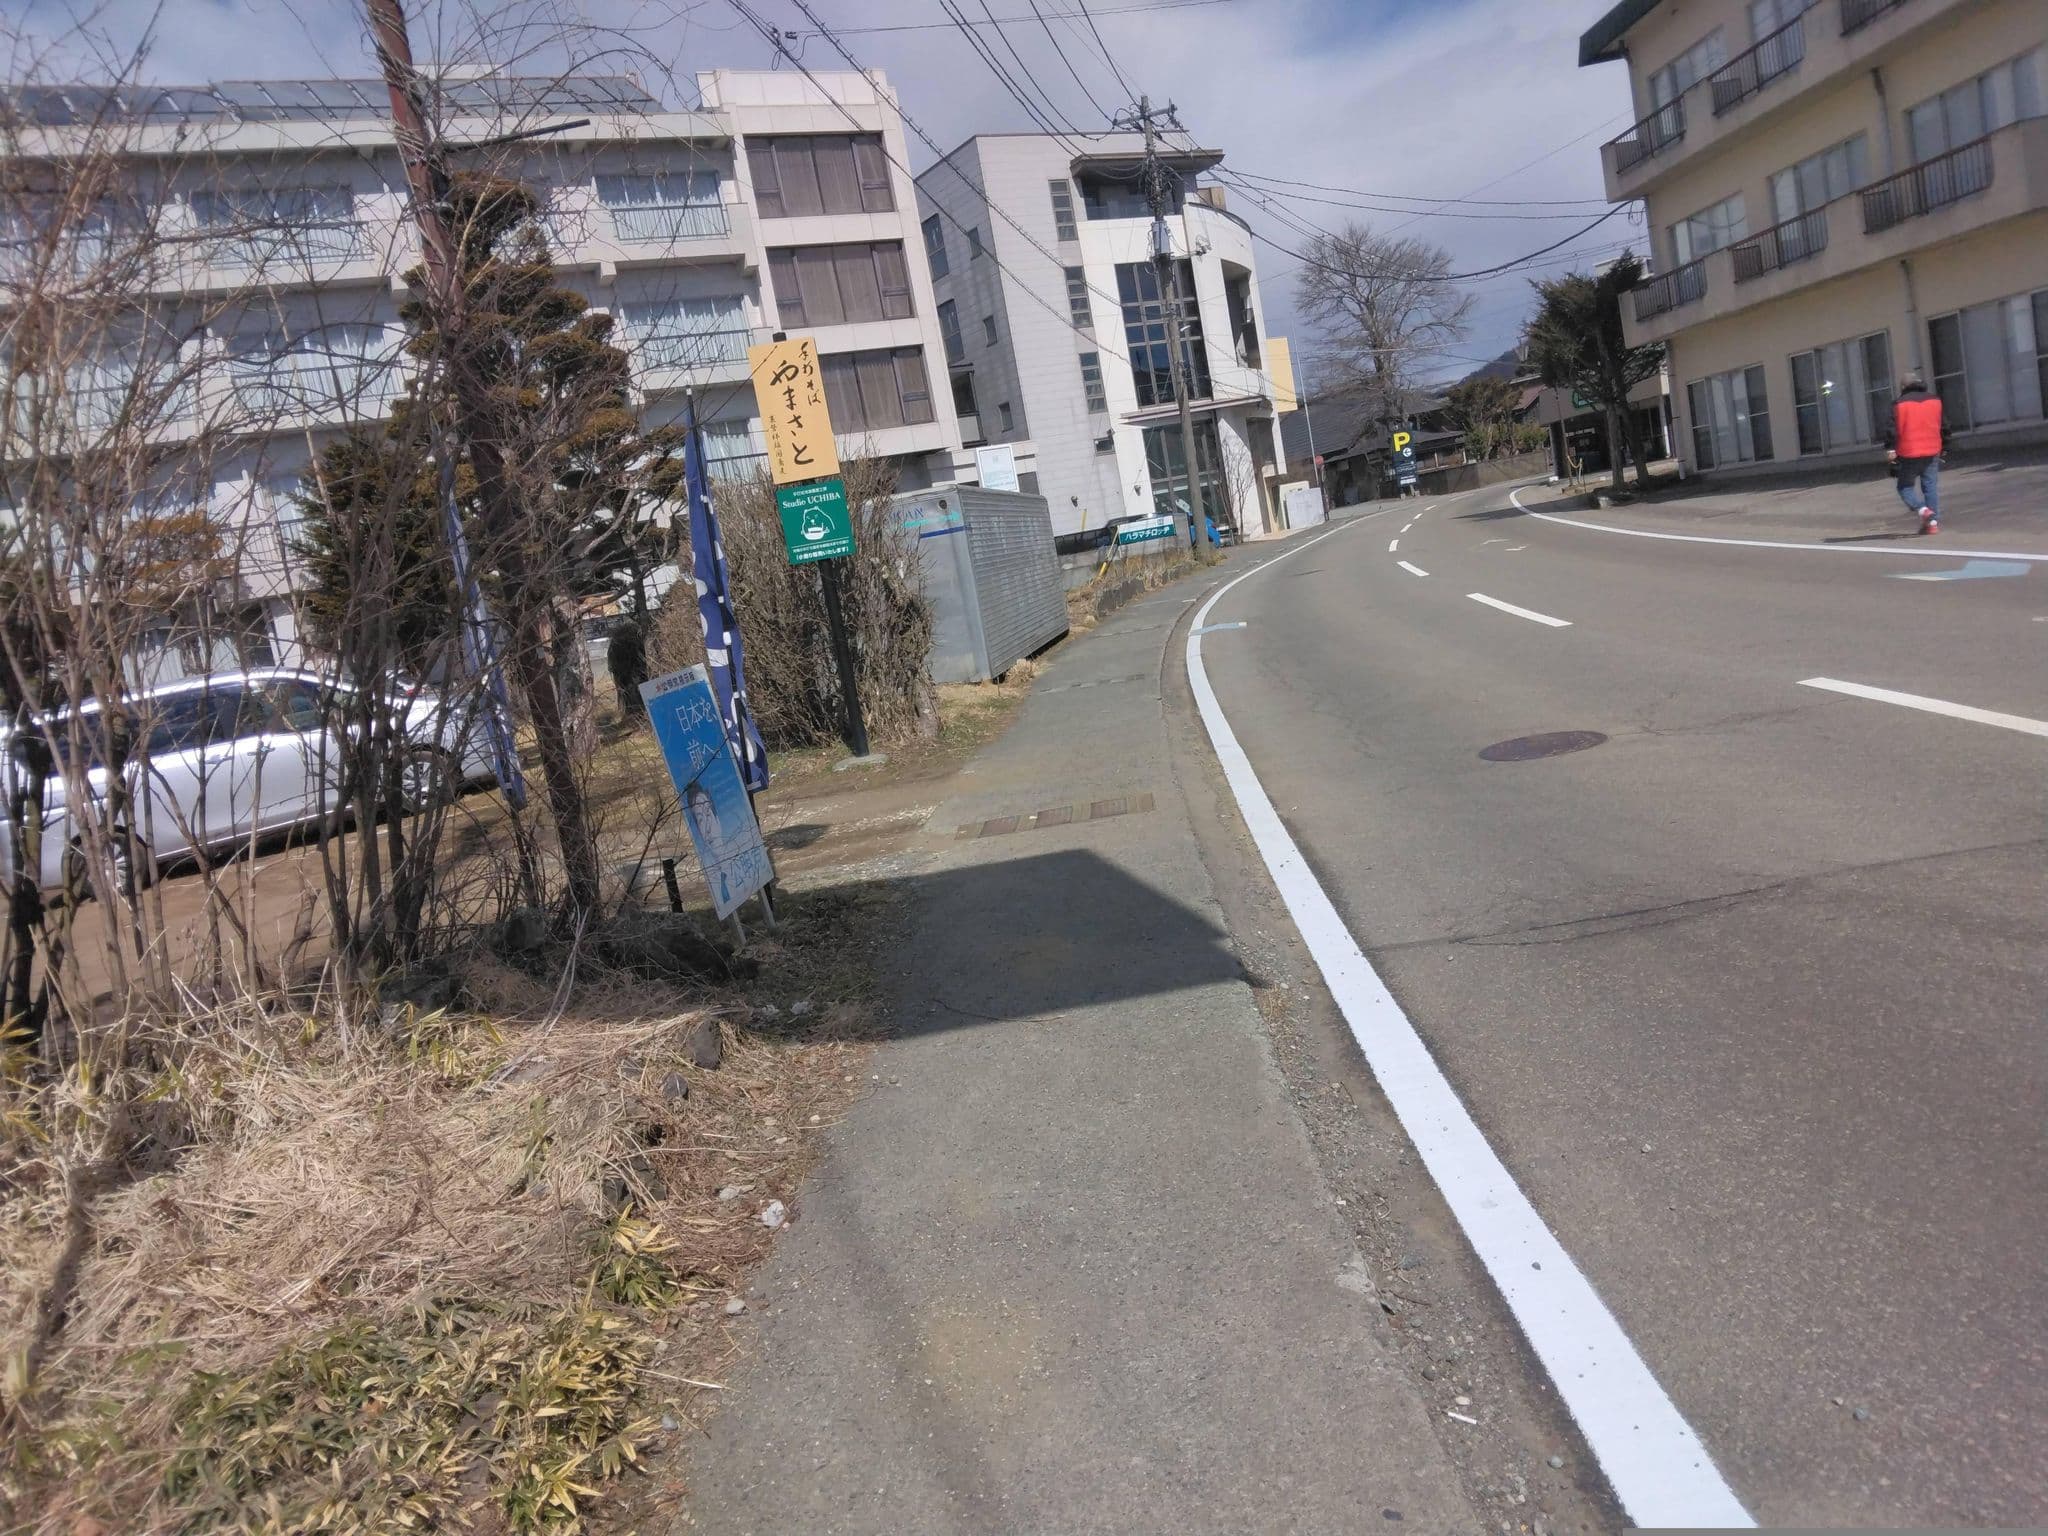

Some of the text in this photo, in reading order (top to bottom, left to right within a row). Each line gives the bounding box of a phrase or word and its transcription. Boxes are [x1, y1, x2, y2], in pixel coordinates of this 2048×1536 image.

[769, 359, 815, 466] やまさと
[1393, 431, 1410, 452] P
[782, 492, 841, 509] Studio UCHIBA
